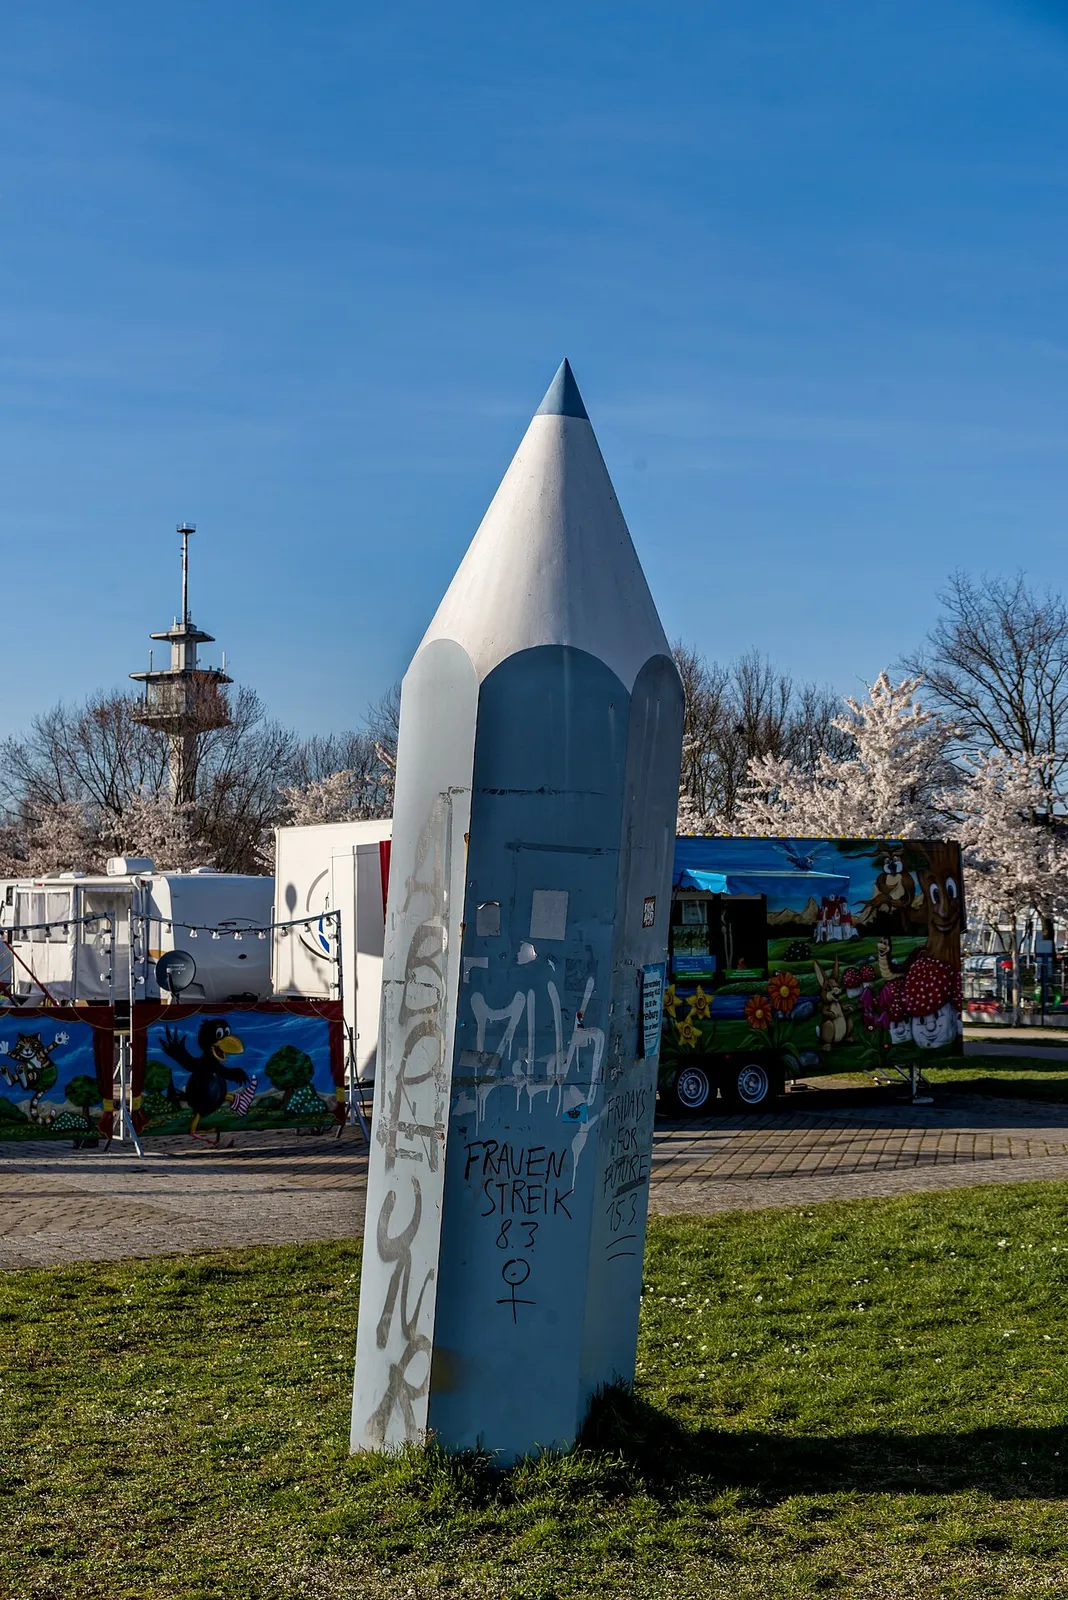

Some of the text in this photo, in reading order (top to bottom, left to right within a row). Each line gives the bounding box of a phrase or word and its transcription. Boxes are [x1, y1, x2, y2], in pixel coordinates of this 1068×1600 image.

[606, 1089, 647, 1129] FRIDAYS
[617, 1126, 638, 1156] FOR
[463, 1139, 568, 1185] FRAUEN
[480, 1178, 575, 1220] STREIK
